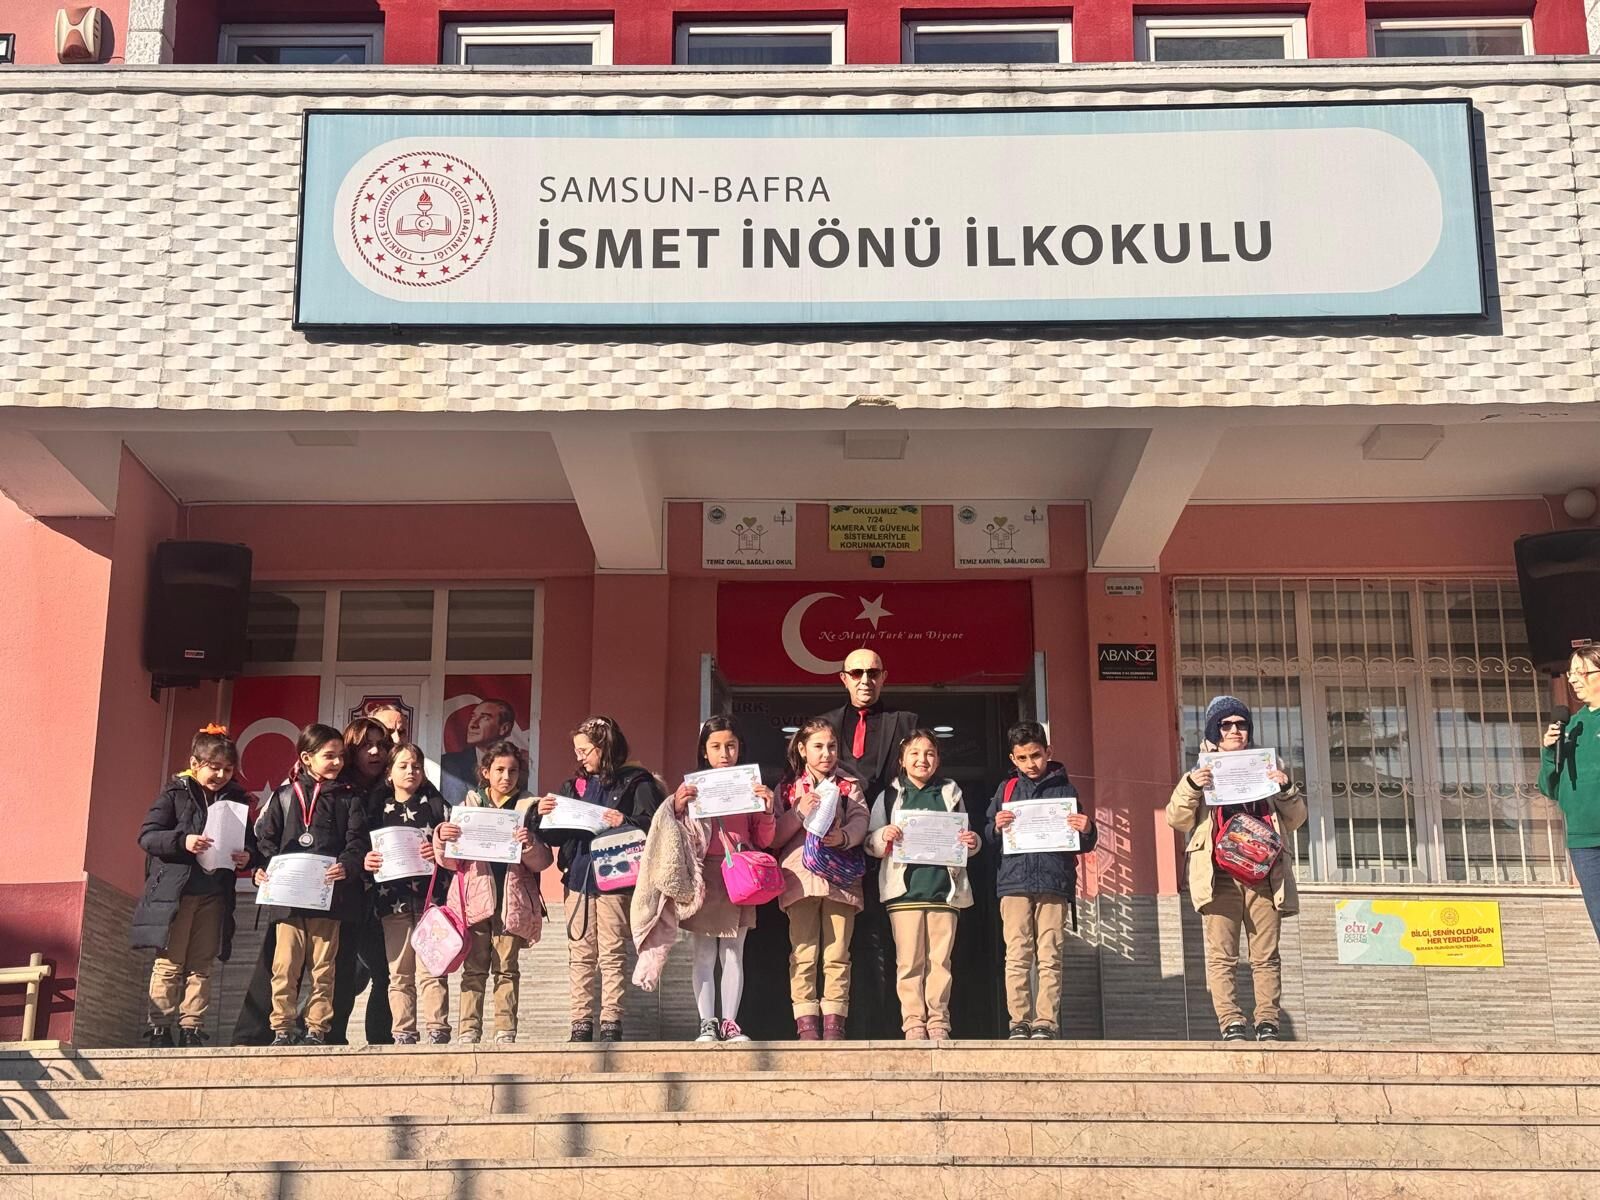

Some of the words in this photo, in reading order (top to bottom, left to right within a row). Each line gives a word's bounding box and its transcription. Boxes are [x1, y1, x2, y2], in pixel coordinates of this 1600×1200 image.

[422, 175, 450, 188] MİLLİ
[539, 176, 831, 203] SAMSUN-BAFRA
[378, 176, 420, 229] CUMHURİYETİ
[449, 185, 471, 216] EĞİTİM
[380, 230, 413, 260] TÜRKİYE
[433, 219, 471, 260] BAKANLIĞI
[537, 218, 720, 269] İSMET
[742, 217, 941, 269] İNÖNÜ
[966, 216, 1272, 267] İLKOKULU
[852, 507, 898, 515] OKULUMUZ
[831, 524, 865, 532] KAMERA
[867, 524, 877, 532] VE
[879, 523, 920, 532] GÜVENLİK
[843, 532, 906, 540] SİSTEMLERİYLE
[840, 541, 910, 549] KORUNMAKTADIR
[818, 631, 836, 642] Ne
[837, 631, 876, 641] Mutlu
[925, 630, 964, 642] Diyene
[1099, 649, 1155, 662] ABANOZ
[1410, 929, 1432, 938] BİLGİ,
[1432, 927, 1455, 937] SENİN
[1455, 926, 1495, 935] OLDUĞUN
[1427, 937, 1442, 945] HER
[1442, 935, 1481, 944] YERDEDİR.
